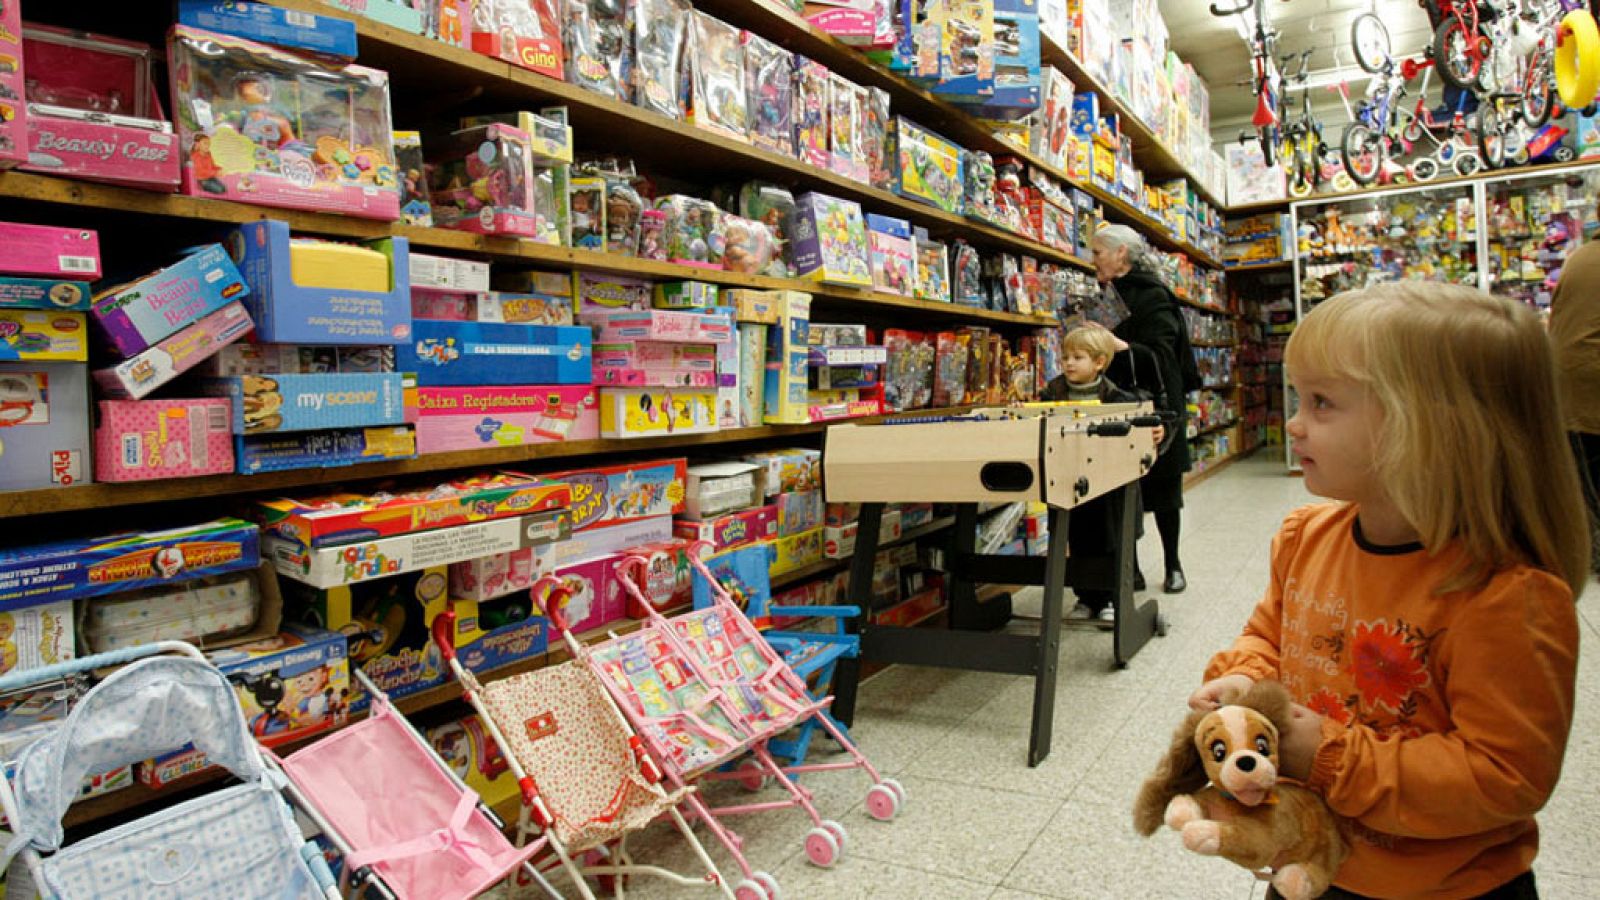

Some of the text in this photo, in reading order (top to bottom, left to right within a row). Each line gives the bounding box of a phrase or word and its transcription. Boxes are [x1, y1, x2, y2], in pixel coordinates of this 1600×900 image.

[37, 131, 169, 162] Beauty Case
[147, 277, 201, 312] Beauty
[297, 390, 378, 410] my scene
[417, 394, 457, 408] Caixa
